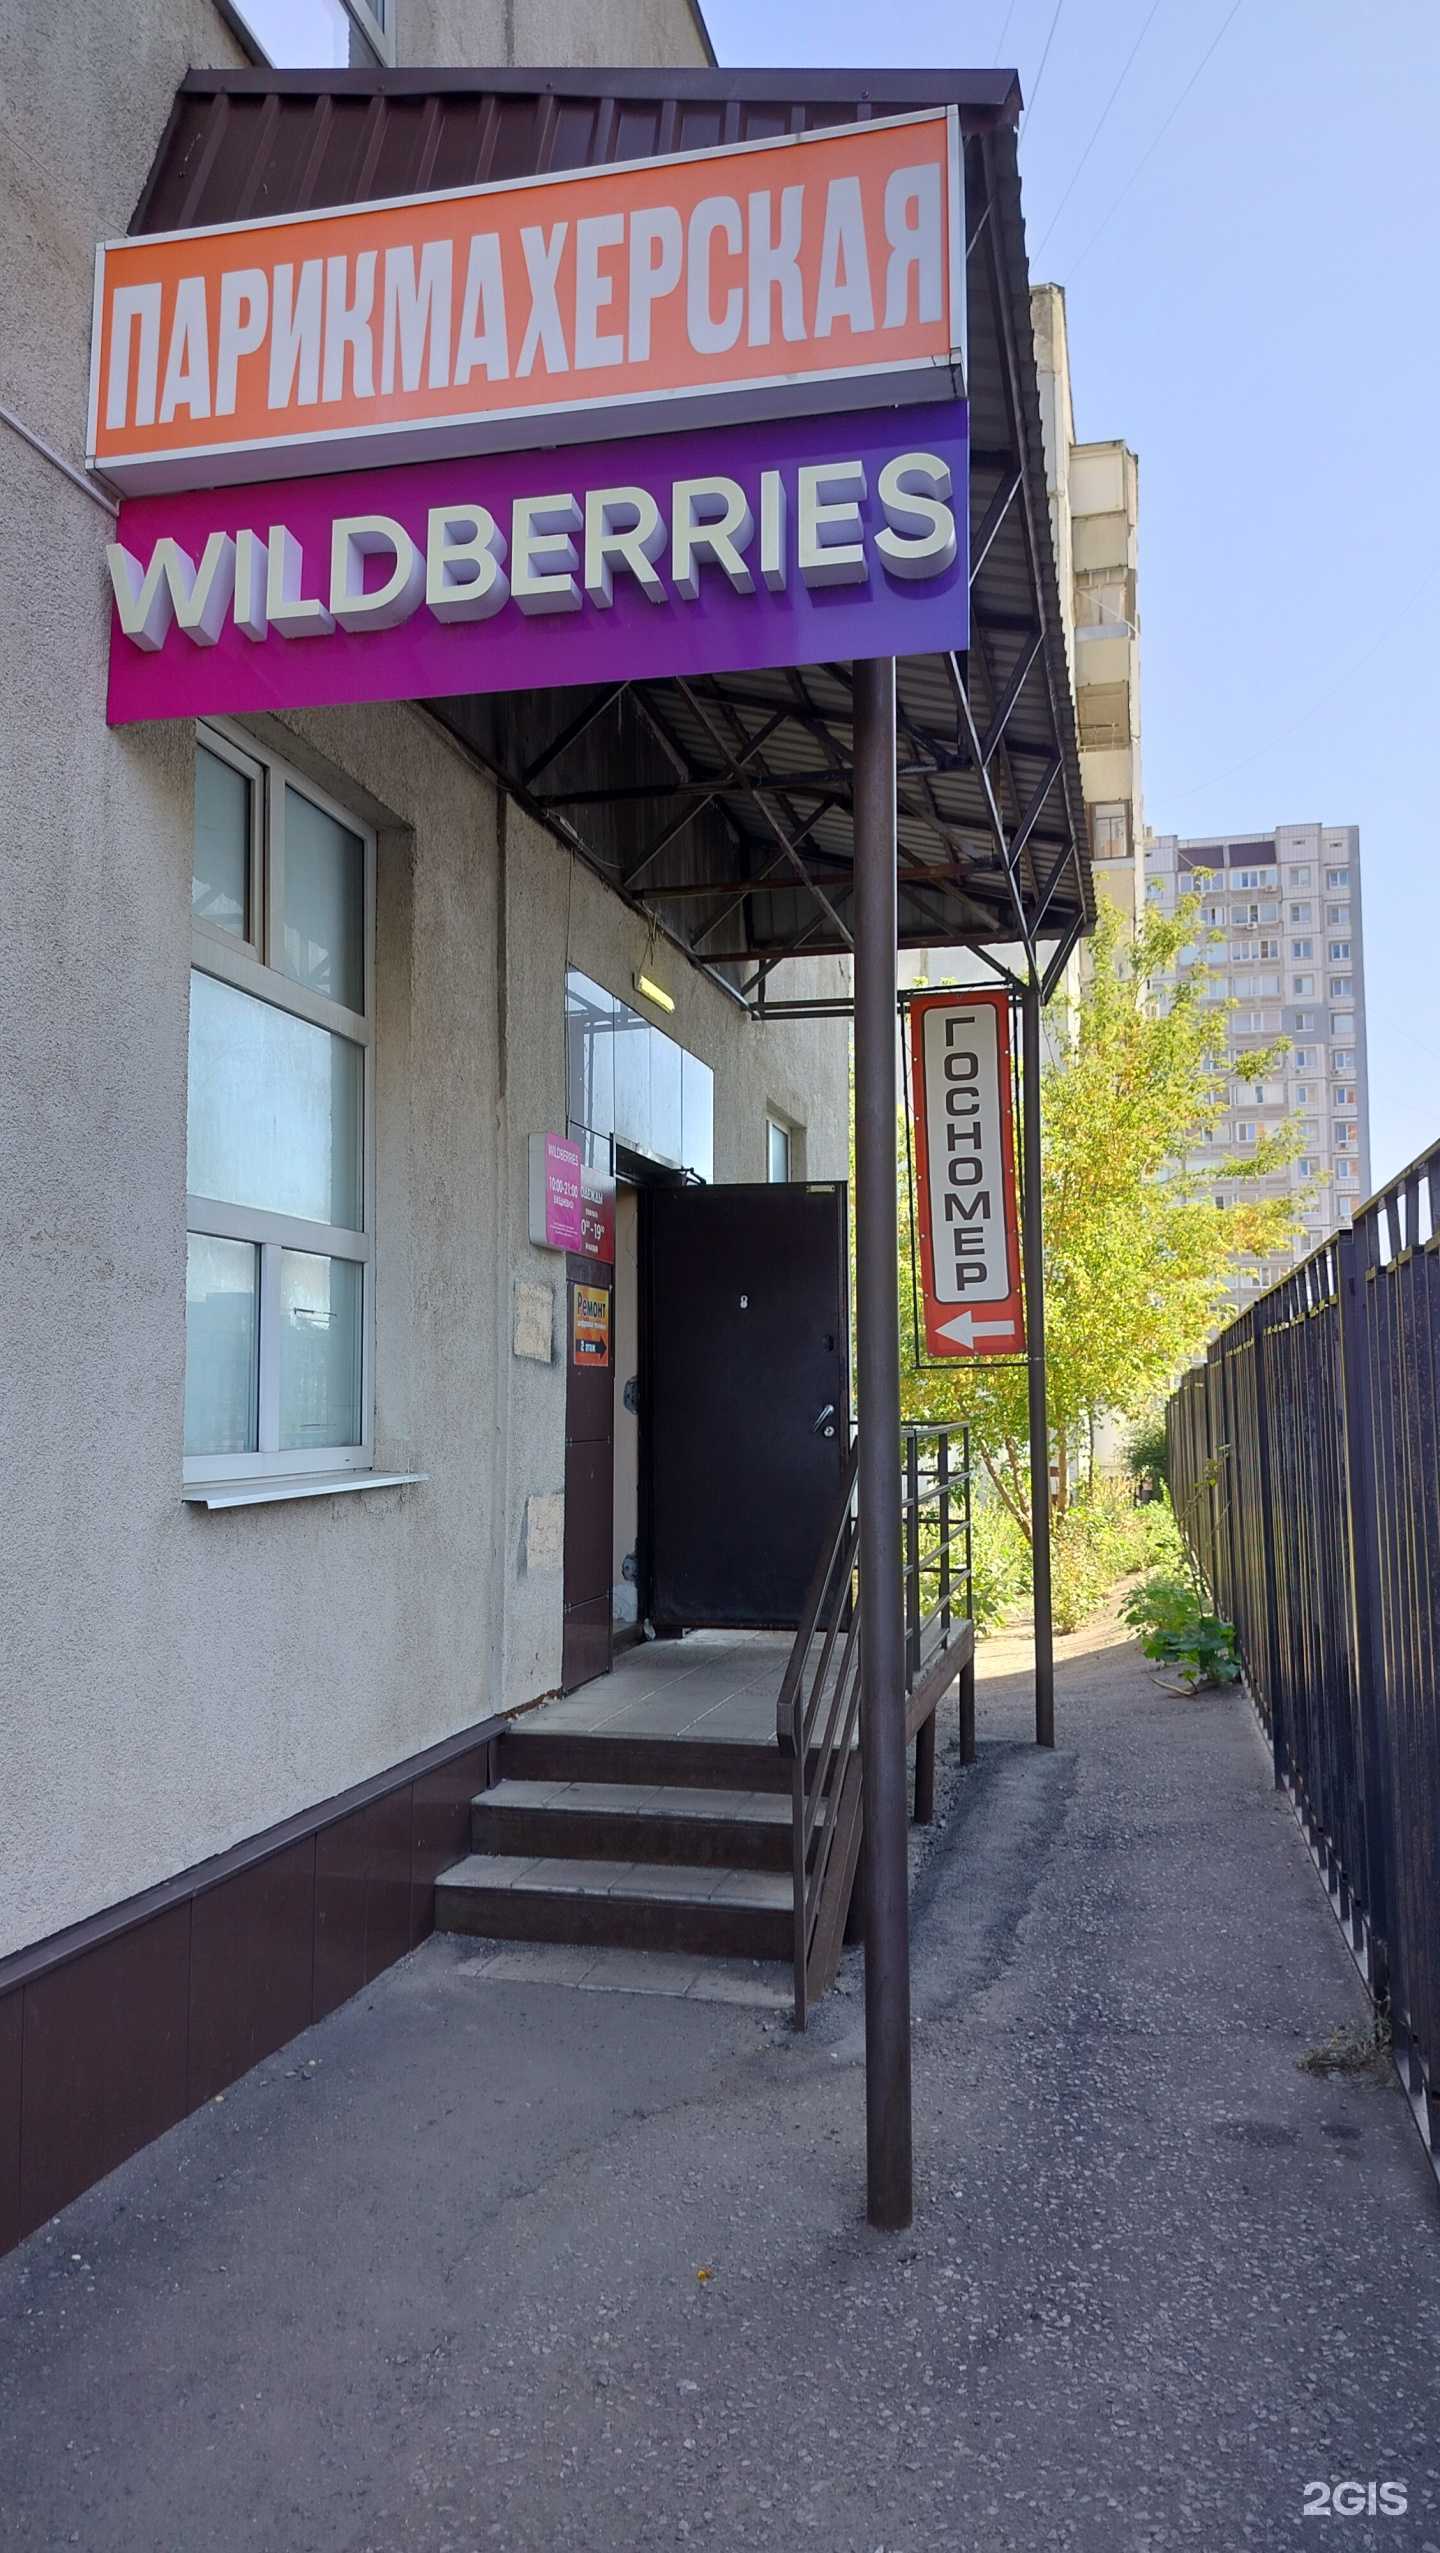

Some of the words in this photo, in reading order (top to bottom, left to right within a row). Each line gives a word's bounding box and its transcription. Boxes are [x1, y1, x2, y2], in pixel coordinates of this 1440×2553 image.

[105, 163, 942, 430] ПАРИКМАХЕРСКАЯ
[106, 452, 957, 652] WILDBERRIES
[943, 1017, 991, 1291] ГОСНОМЕР
